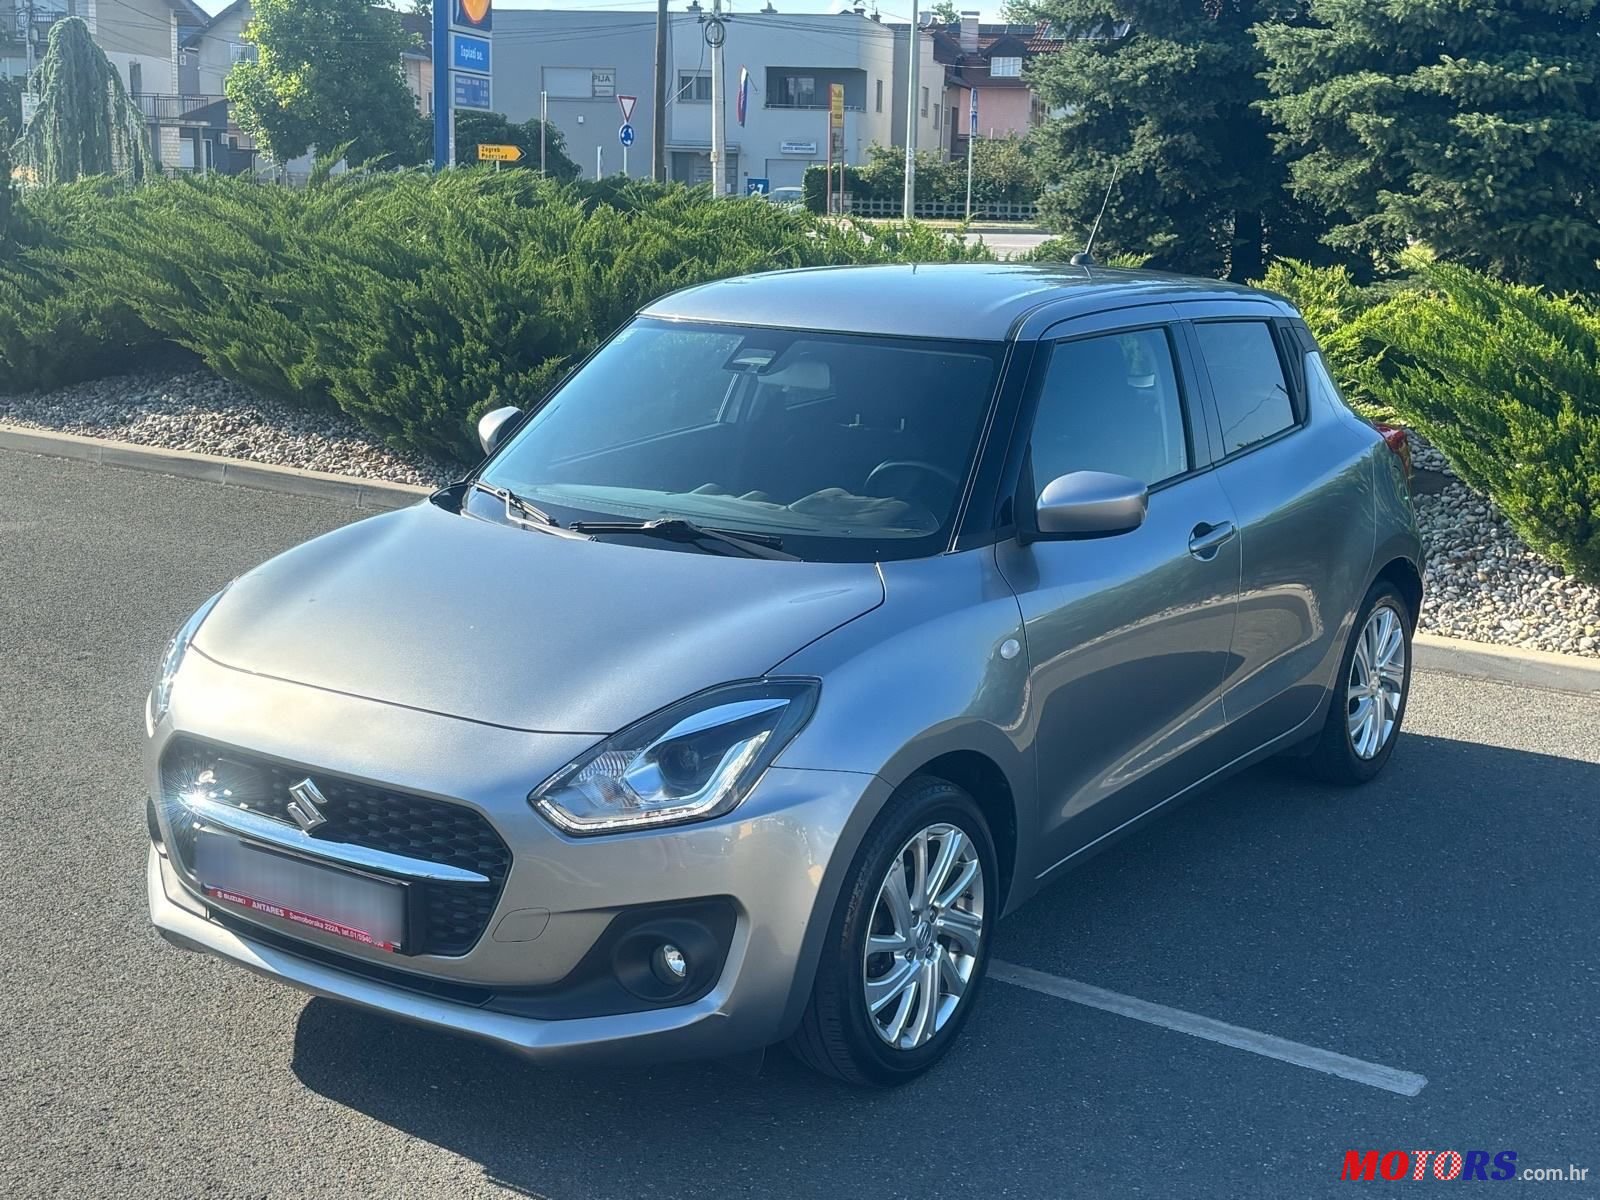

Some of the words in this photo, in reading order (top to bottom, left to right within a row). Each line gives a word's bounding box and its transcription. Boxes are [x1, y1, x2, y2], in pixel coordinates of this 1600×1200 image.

[223, 893, 246, 905] SUZUKI
[252, 901, 285, 917] ANTARES
[289, 912, 324, 929] Samoborska
